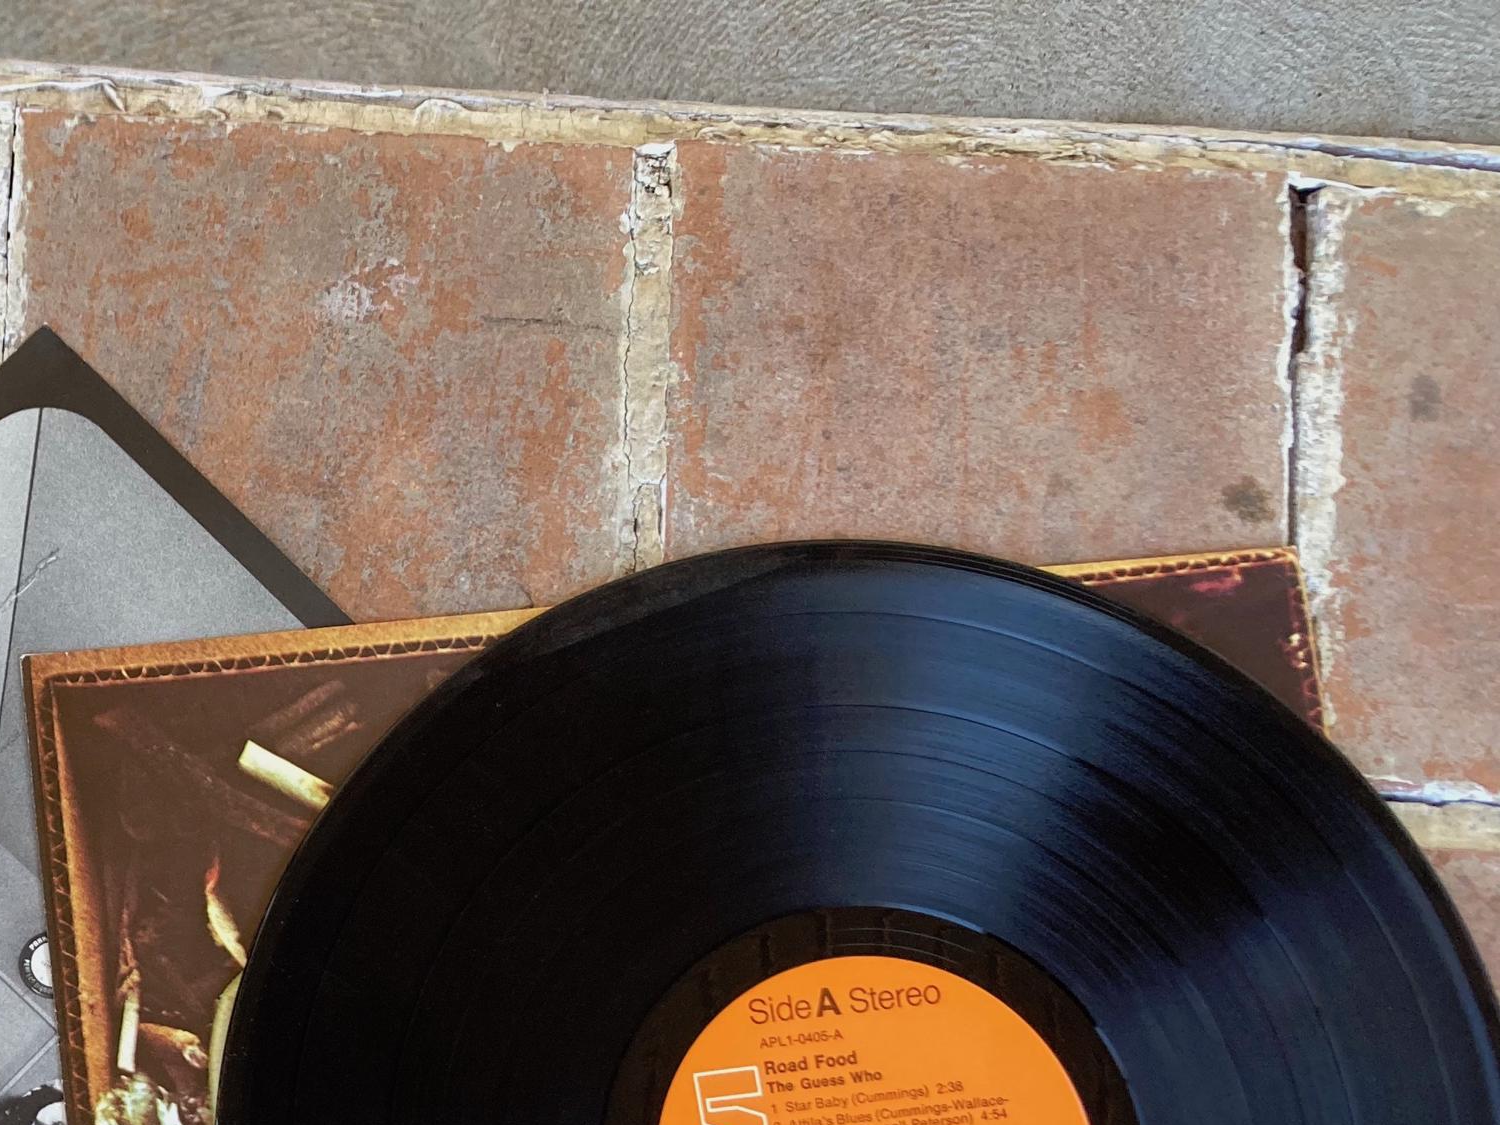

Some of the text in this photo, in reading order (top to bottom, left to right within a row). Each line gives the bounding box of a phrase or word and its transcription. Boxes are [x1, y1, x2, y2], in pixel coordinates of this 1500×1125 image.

[748, 976, 942, 1026] Side A Stereo
[763, 1050, 858, 1075] Road Food
[766, 1068, 883, 1094] The Guess Who
